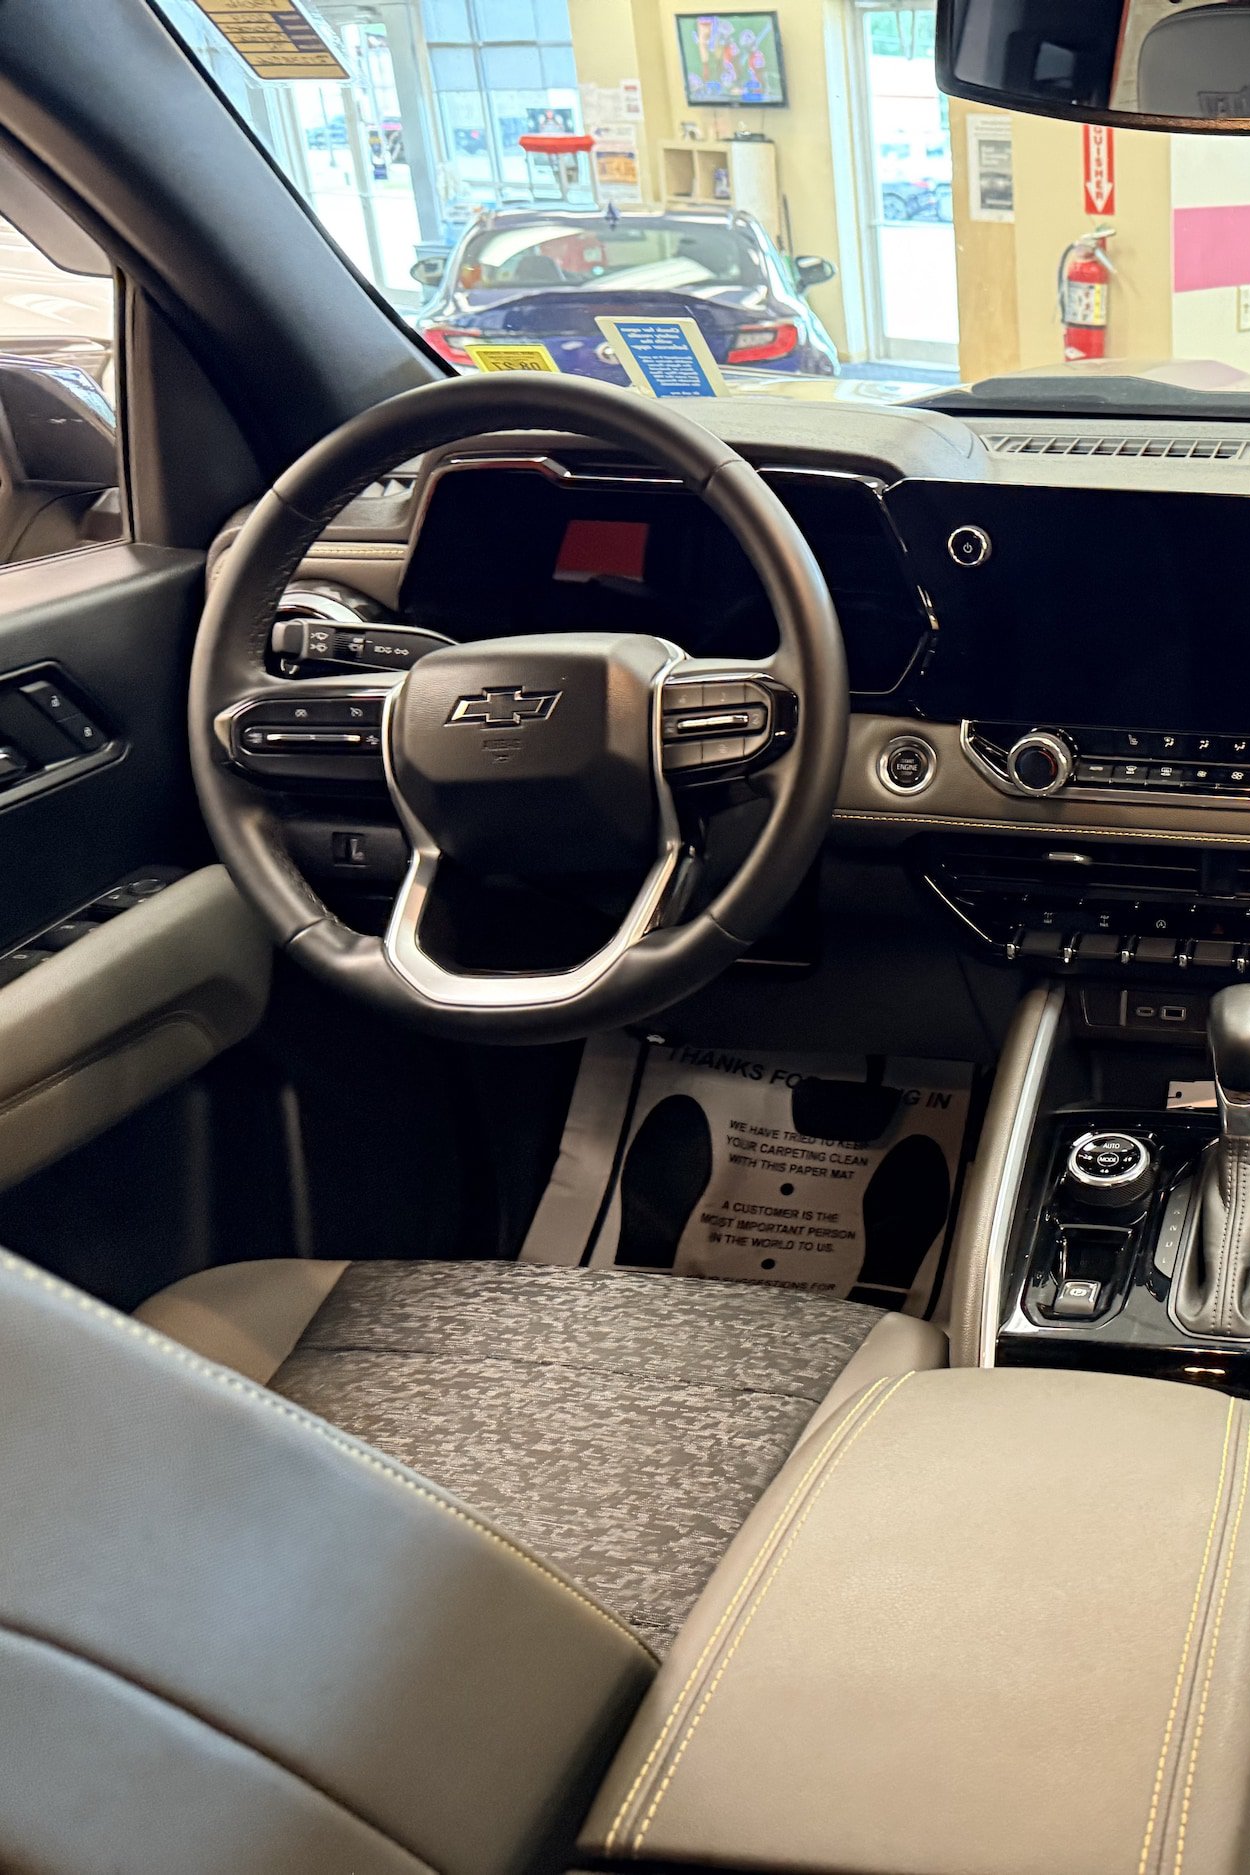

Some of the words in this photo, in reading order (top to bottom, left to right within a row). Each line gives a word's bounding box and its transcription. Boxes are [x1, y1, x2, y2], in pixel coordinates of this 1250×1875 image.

[896, 763, 918, 771] ENGINE
[926, 1092, 953, 1109] IN
[730, 1120, 747, 1132] WE
[750, 1125, 780, 1139] HAVE
[727, 1135, 757, 1151] YOUR
[759, 1144, 826, 1162] CARPETING
[828, 1153, 868, 1166] CLEAN
[728, 1154, 757, 1168] WITH
[761, 1159, 786, 1172] THIS
[789, 1165, 827, 1178] PAPER
[830, 1169, 855, 1180] MAT
[722, 1201, 730, 1210] A
[733, 1202, 799, 1219] CUSTOMER
[802, 1211, 813, 1220] IS
[816, 1211, 839, 1223] THE
[700, 1213, 735, 1227] MOST
[736, 1220, 805, 1235] IMPORTANT
[807, 1227, 856, 1240] PERSON
[724, 1234, 747, 1247] THE
[751, 1237, 794, 1250] WORLD
[798, 1241, 814, 1251] TO
